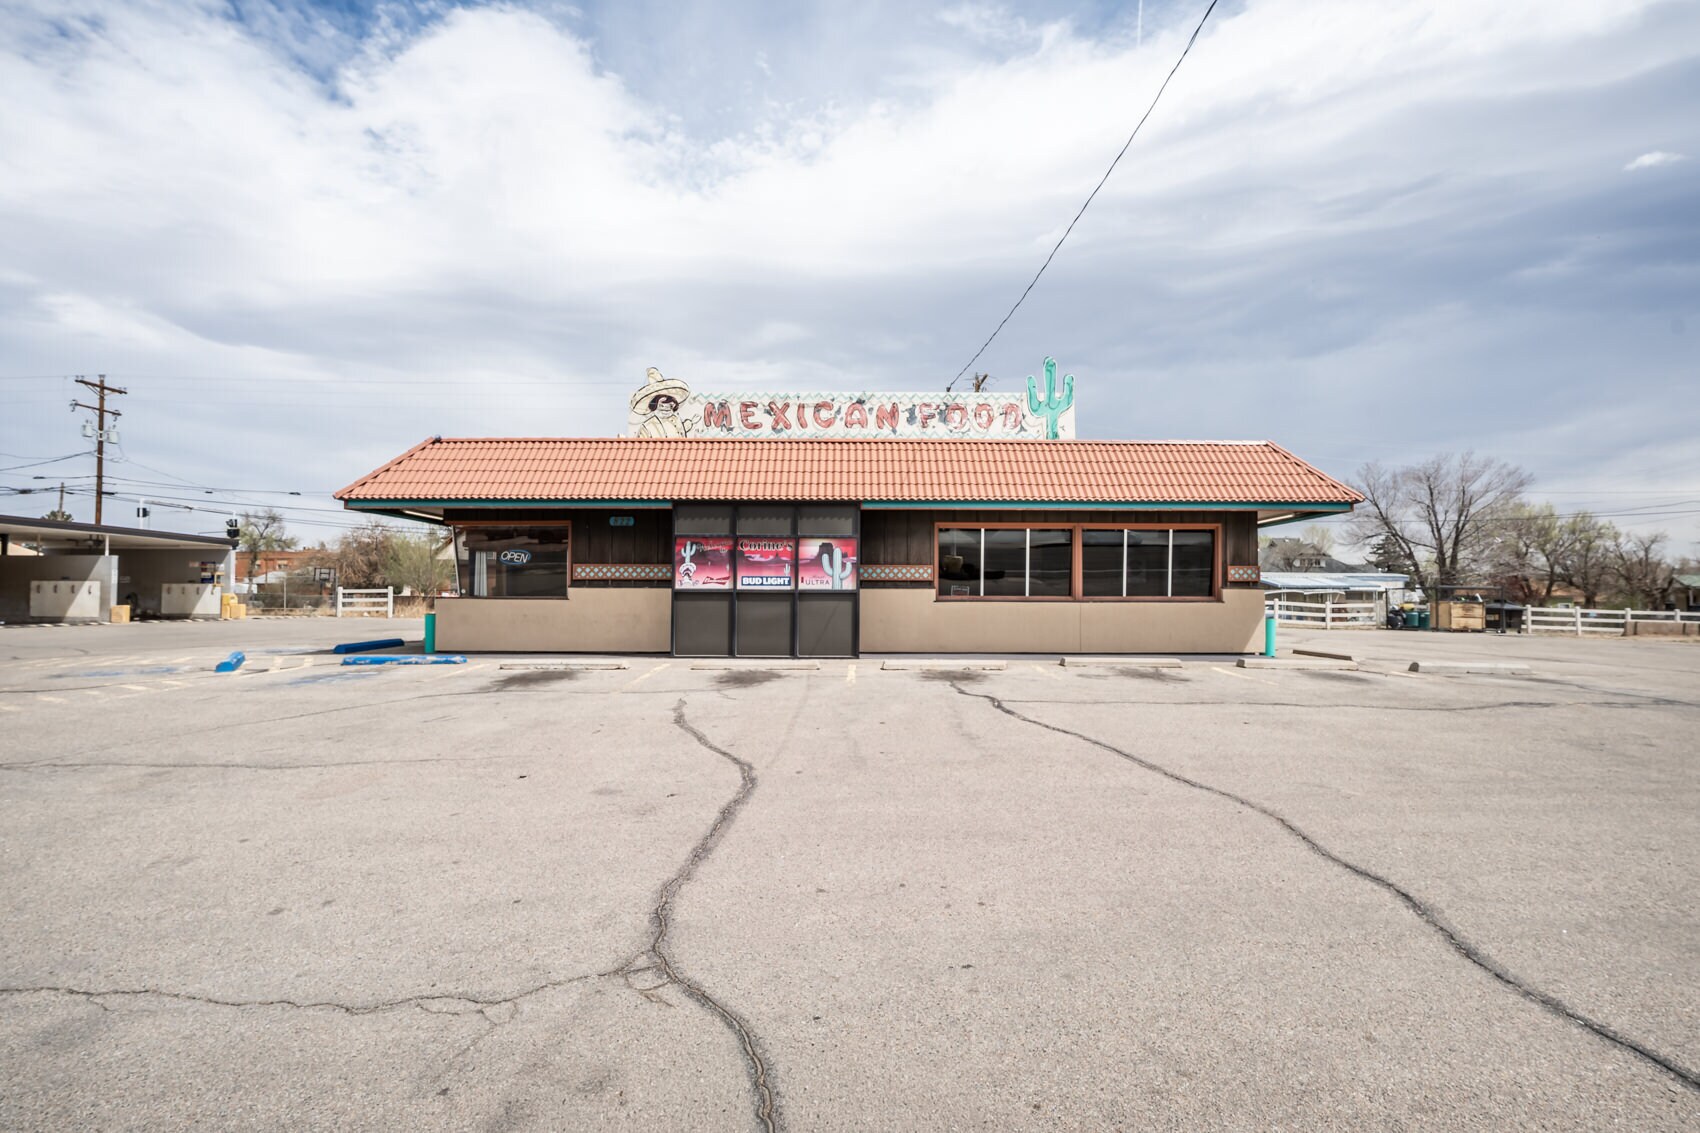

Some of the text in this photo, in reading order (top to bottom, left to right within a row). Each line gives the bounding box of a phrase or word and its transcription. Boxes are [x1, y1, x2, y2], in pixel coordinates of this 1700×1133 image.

[703, 400, 1024, 430] MEXICAN FOOD
[739, 539, 793, 552] Corine's
[500, 551, 528, 563] OPEN
[742, 577, 790, 585] BUD LIGHT
